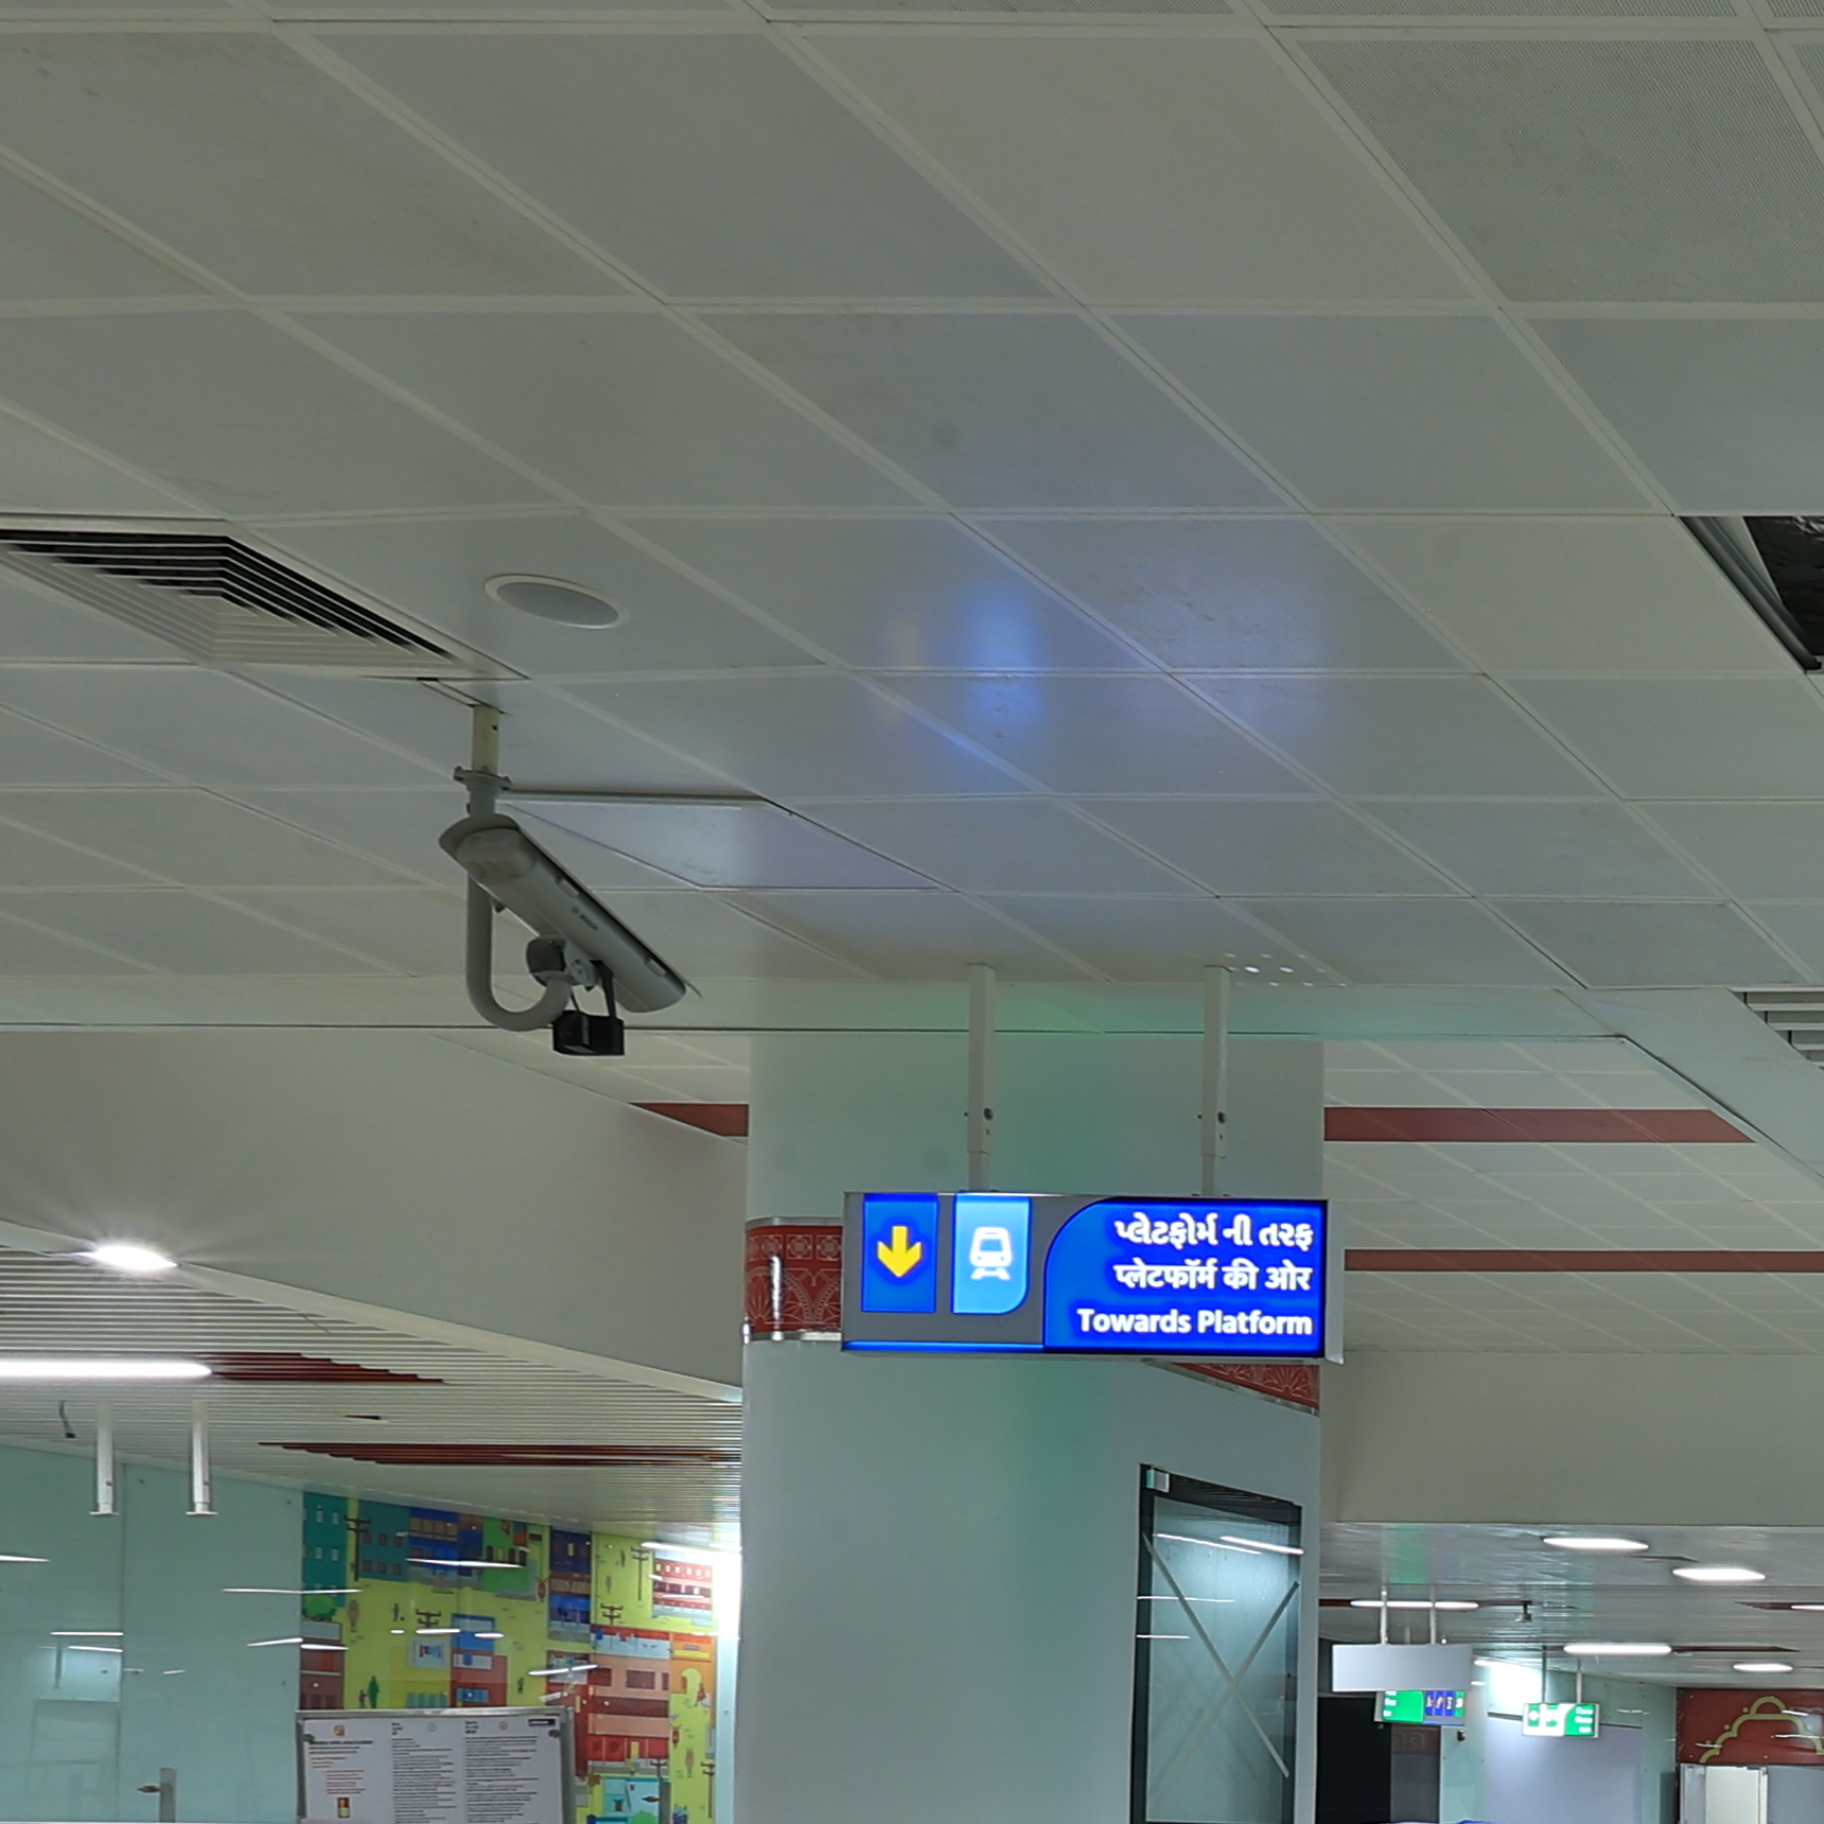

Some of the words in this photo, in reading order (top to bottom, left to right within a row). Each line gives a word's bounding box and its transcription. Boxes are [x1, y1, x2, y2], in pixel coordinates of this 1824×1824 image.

[1114, 1211, 1218, 1250] પ્લેટફોર્મ
[1222, 1213, 1252, 1246] ની
[1258, 1215, 1315, 1250] તરફ
[1113, 1257, 1217, 1290] प्लेटफॉर्म
[1222, 1260, 1258, 1290] की
[1264, 1260, 1313, 1291] ओर
[1077, 1308, 1192, 1334] Towards
[1197, 1308, 1314, 1336] Platform
